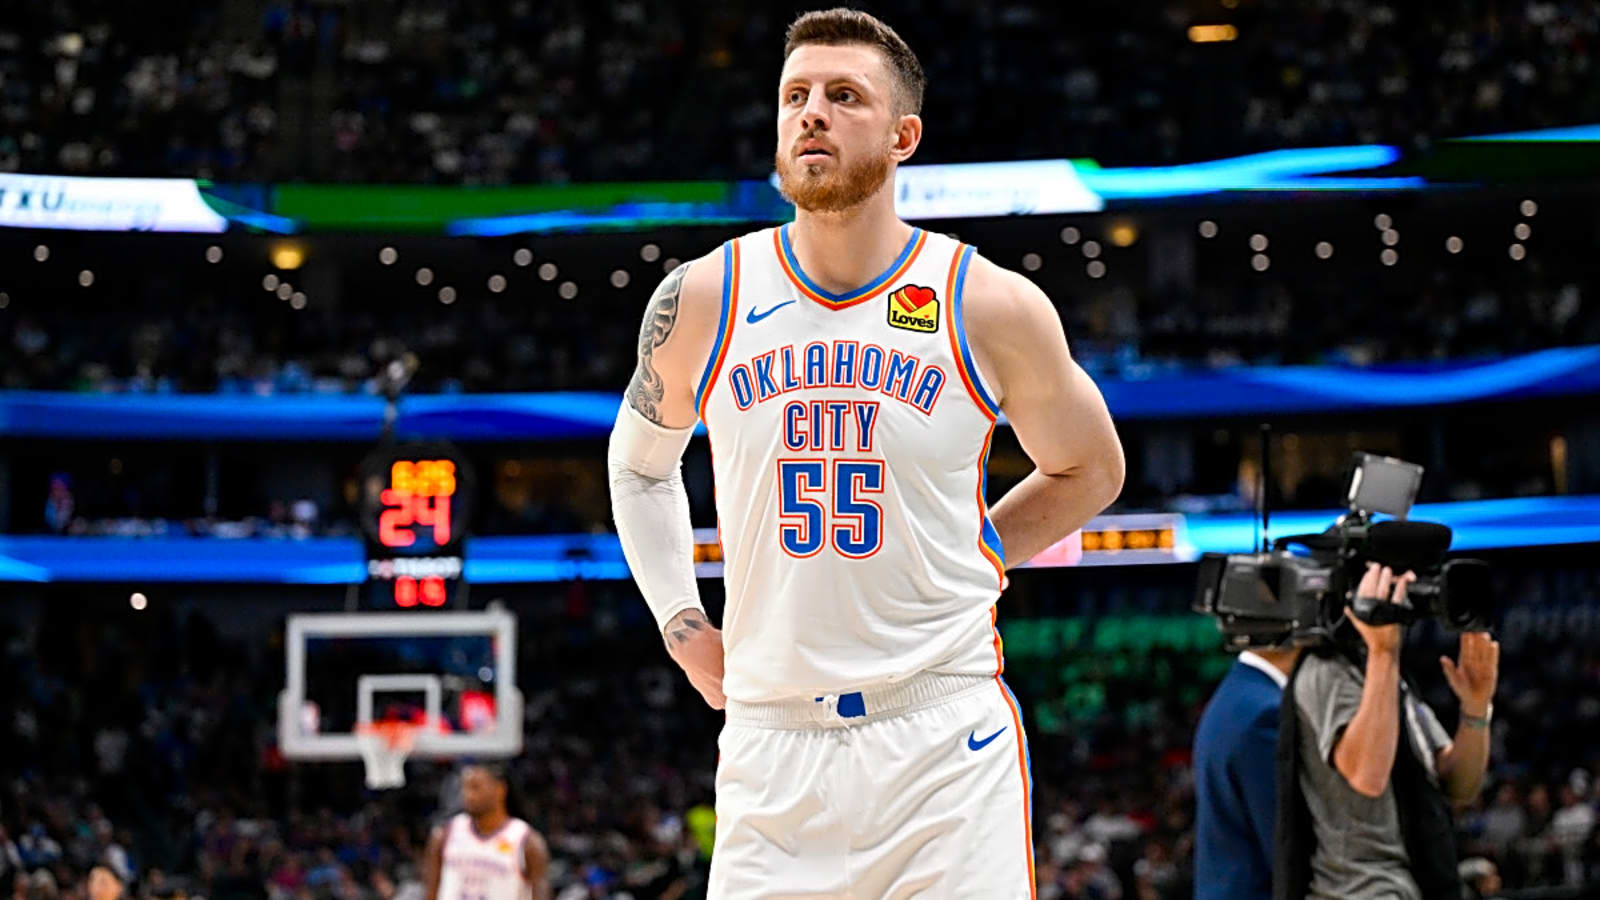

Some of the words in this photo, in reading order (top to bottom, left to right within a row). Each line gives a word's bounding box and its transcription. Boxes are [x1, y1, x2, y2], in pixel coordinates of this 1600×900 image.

[729, 340, 946, 416] OKLAHOMA
[783, 400, 880, 452] CITY
[379, 488, 451, 547] 24
[777, 458, 885, 559] 55
